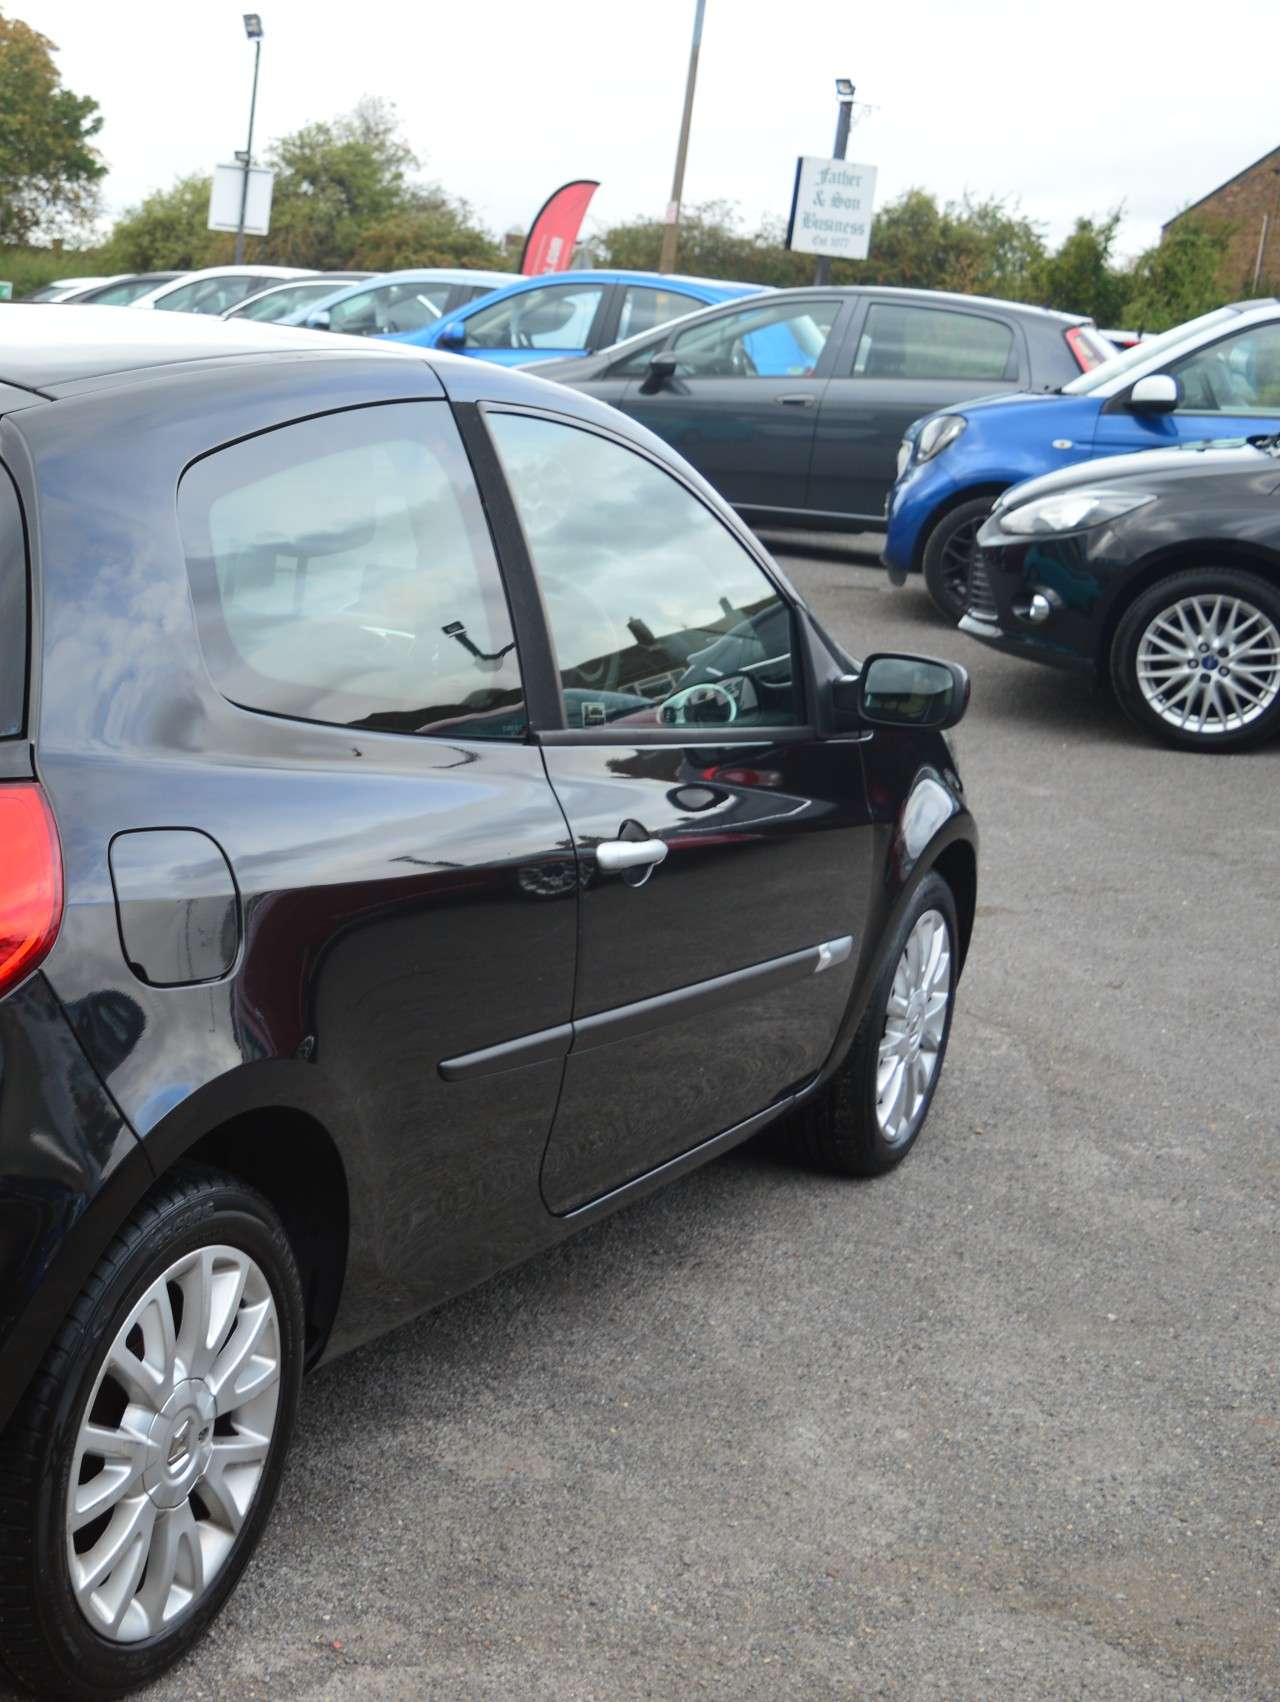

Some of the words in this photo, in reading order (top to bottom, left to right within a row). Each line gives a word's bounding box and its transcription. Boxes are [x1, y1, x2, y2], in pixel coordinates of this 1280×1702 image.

[816, 168, 864, 188] Father
[831, 191, 861, 210] Son
[801, 211, 866, 236] Business
